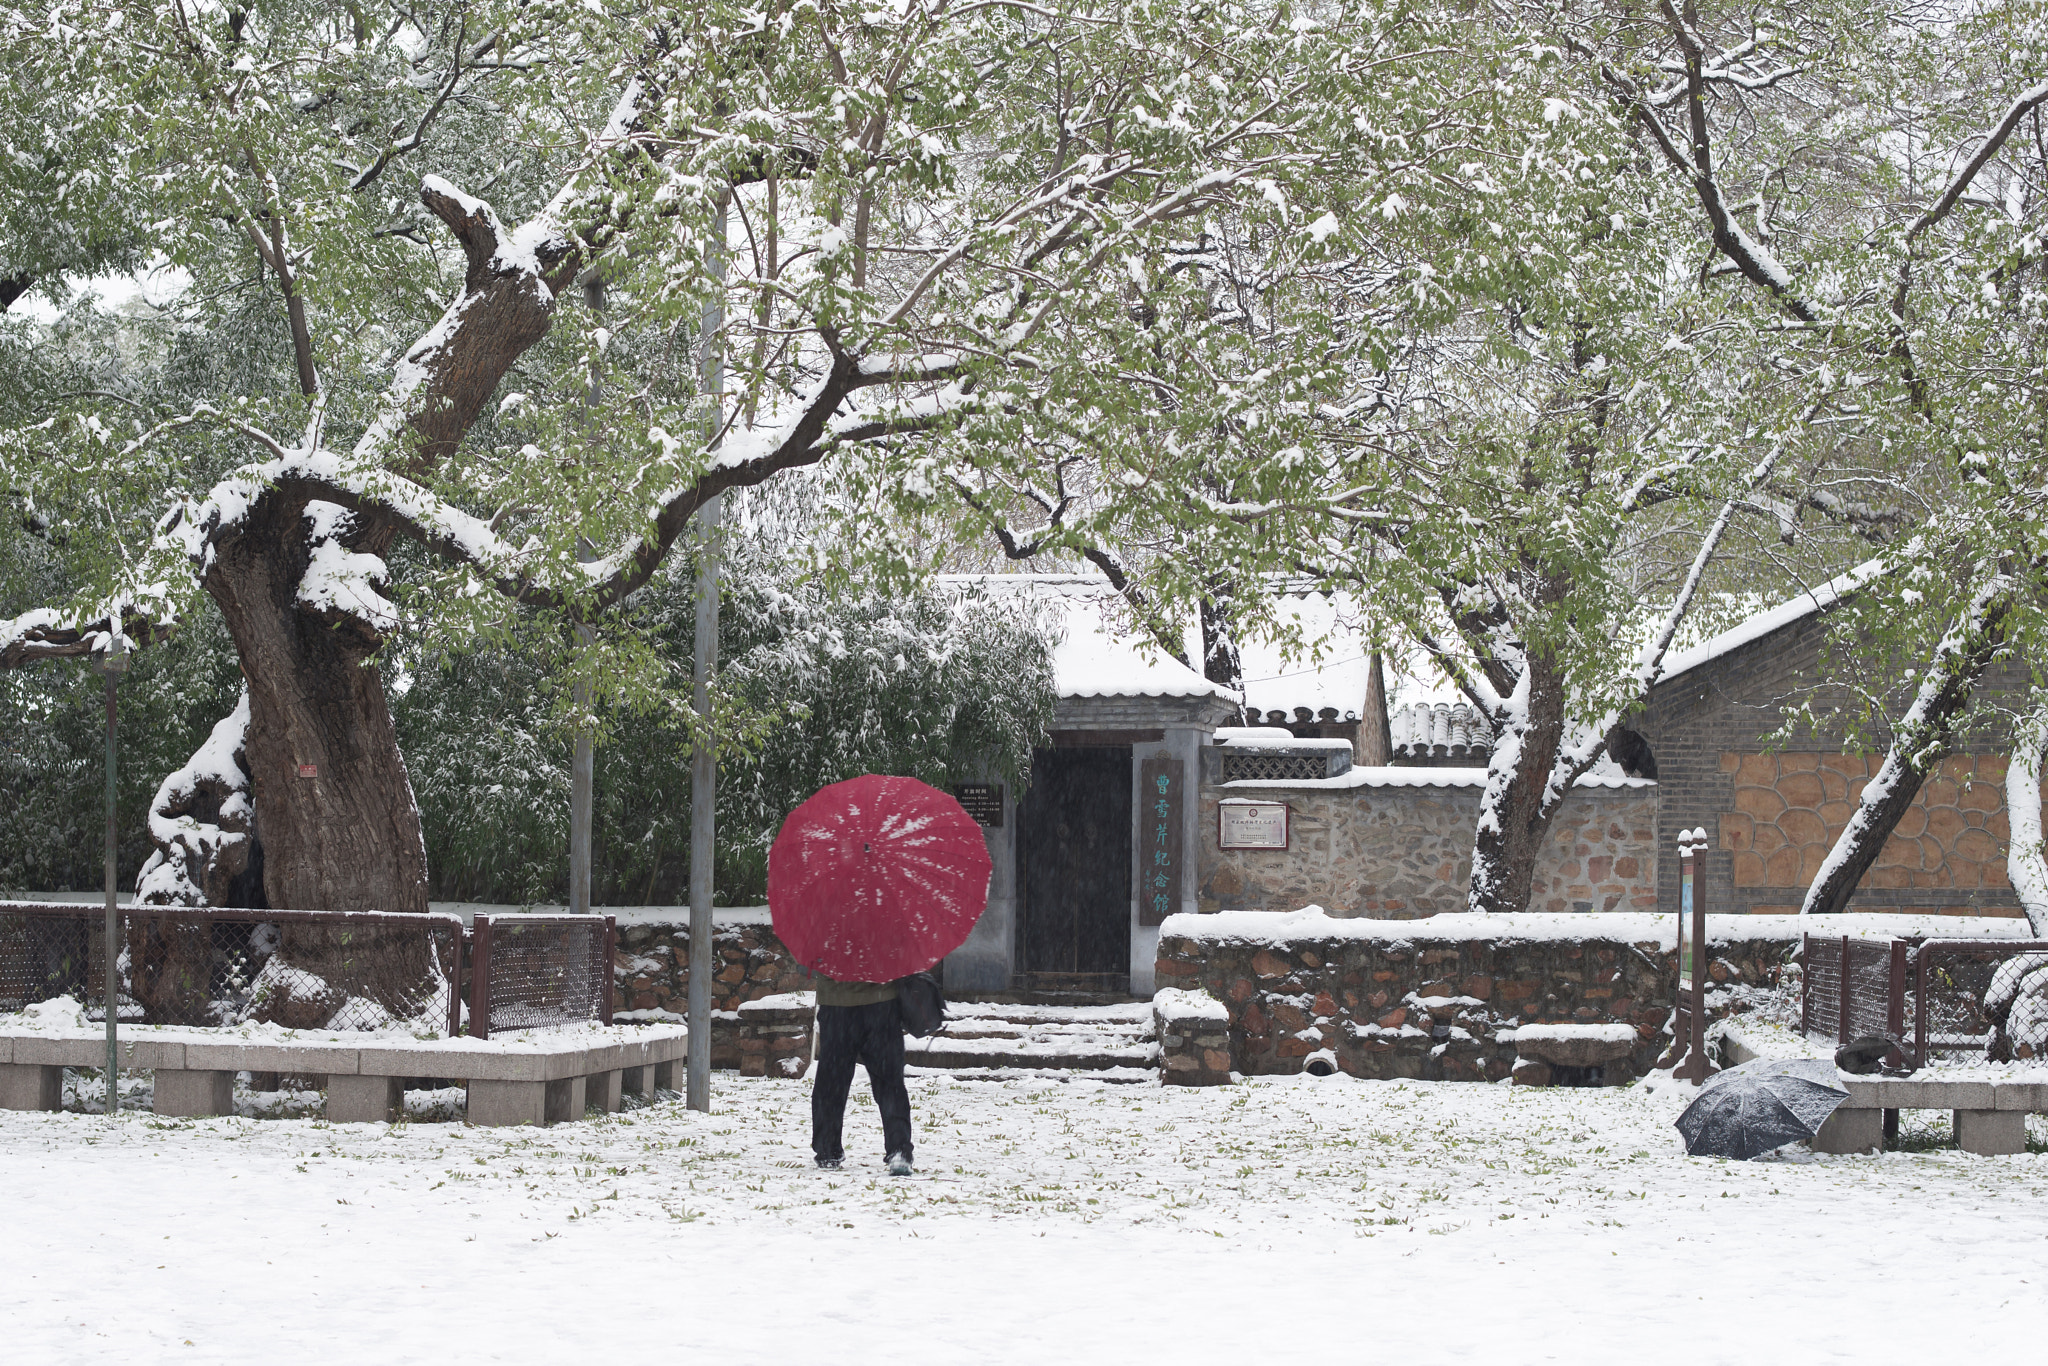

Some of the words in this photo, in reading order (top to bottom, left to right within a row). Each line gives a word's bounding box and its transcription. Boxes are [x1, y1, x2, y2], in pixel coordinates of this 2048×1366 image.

[1153, 772, 1171, 914] 曹雪芹纪念馆
